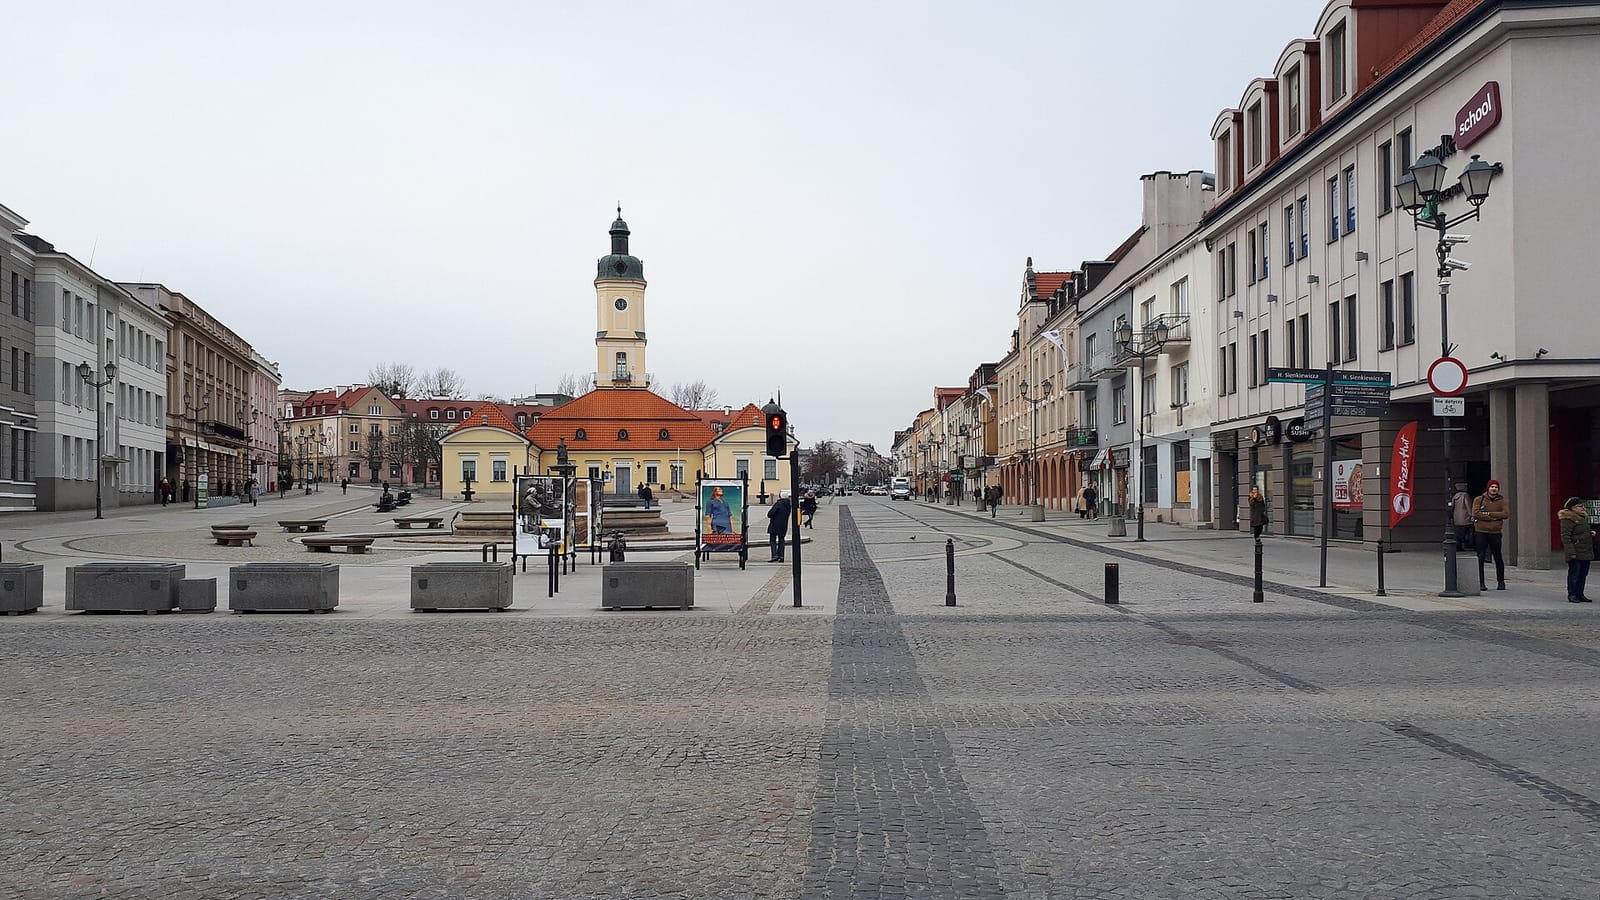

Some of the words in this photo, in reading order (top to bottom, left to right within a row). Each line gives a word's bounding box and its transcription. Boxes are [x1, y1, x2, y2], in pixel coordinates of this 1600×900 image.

[1459, 92, 1492, 137] school
[1349, 374, 1384, 382] Sienkiewicza
[1399, 434, 1410, 459] Hut
[1398, 459, 1410, 491] Pizza
